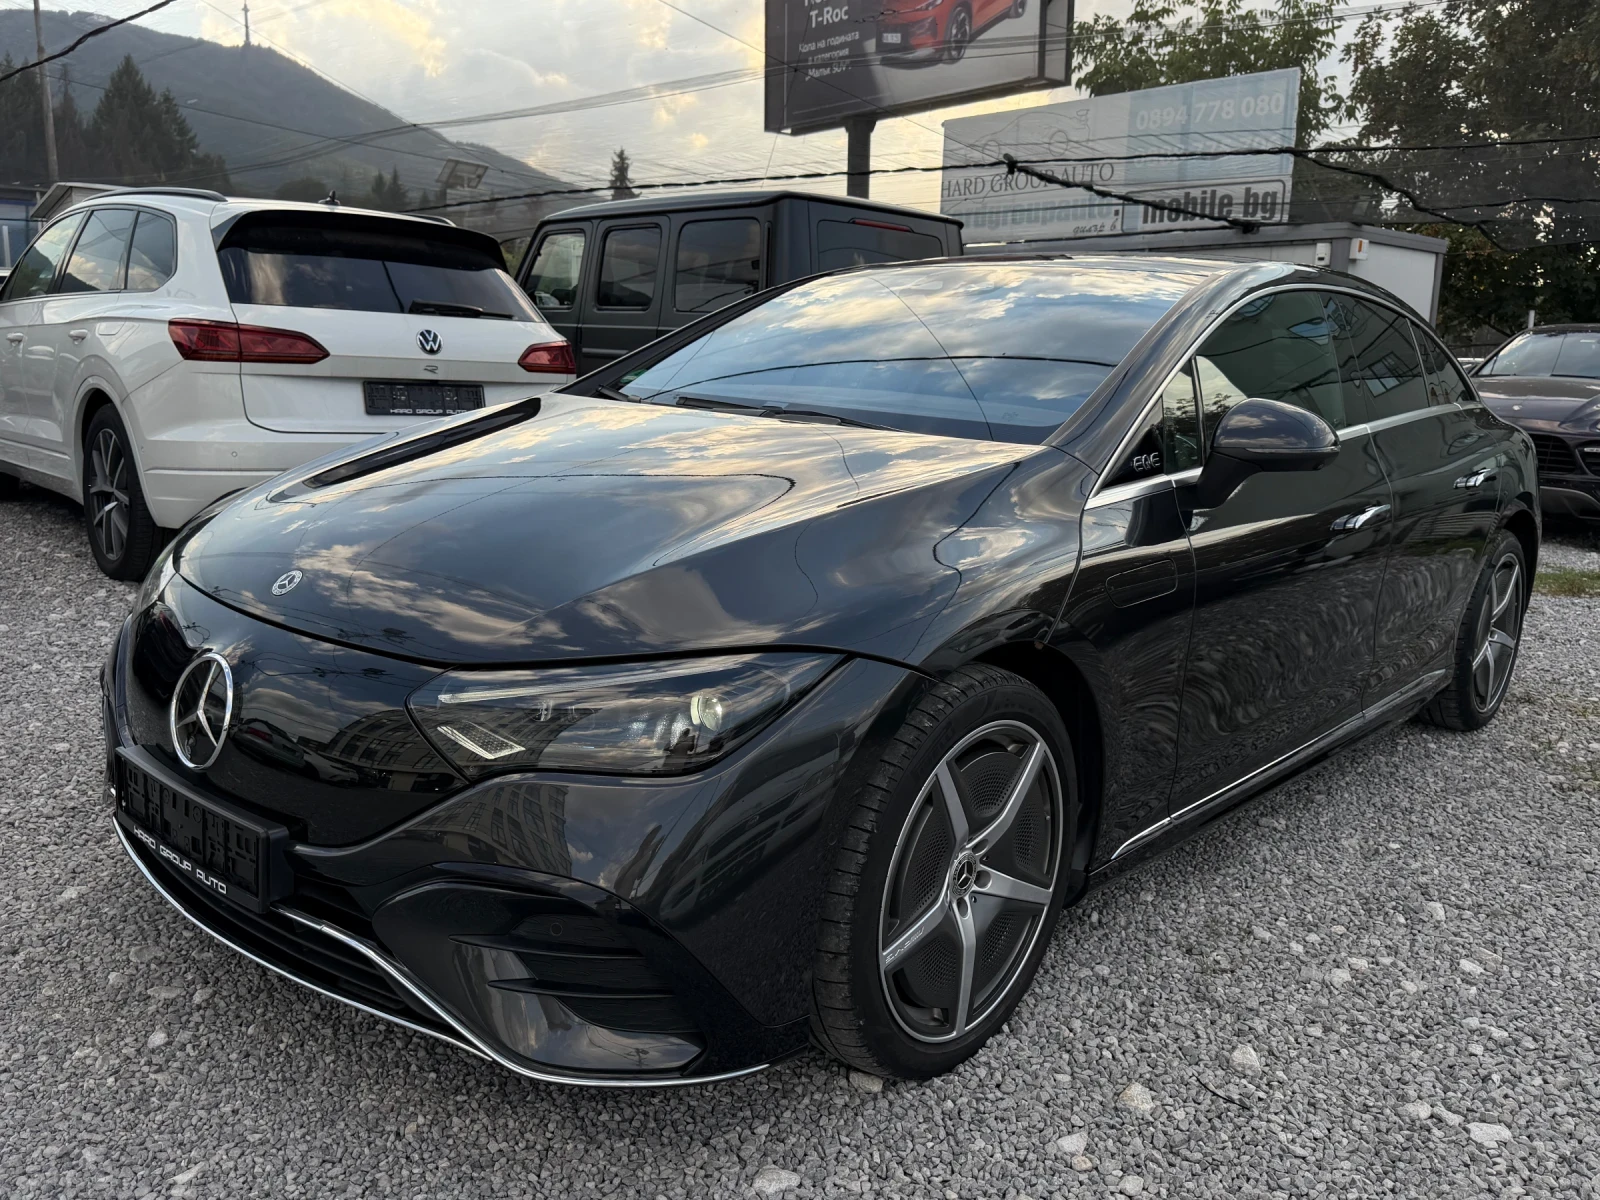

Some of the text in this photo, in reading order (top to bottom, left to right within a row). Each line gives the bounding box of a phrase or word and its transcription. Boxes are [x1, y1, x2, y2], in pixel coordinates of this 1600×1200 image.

[810, 6, 849, 28] T-Roc
[799, 31, 859, 53] Кола на годината
[1136, 93, 1285, 130] 0894 778 080
[942, 162, 1114, 198] HARD GROUP AUTO
[1133, 452, 1161, 472] EQE
[133, 825, 227, 895] HARD GROUP AUTO
